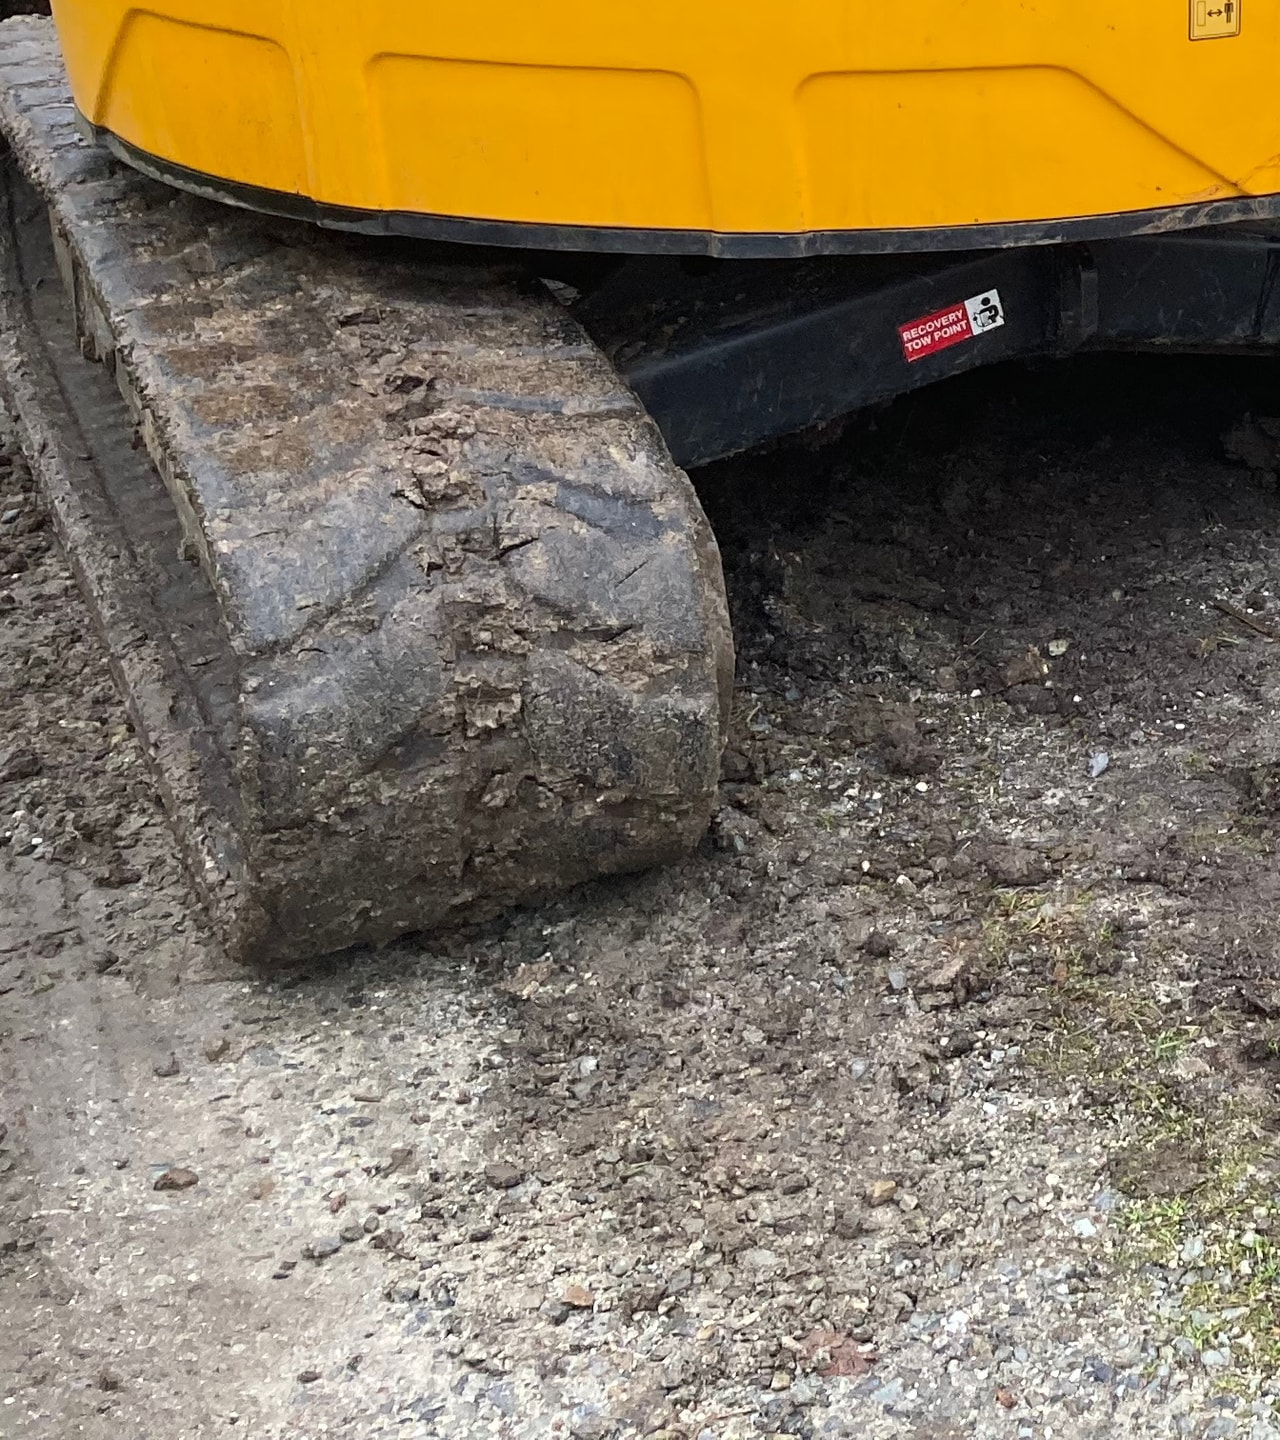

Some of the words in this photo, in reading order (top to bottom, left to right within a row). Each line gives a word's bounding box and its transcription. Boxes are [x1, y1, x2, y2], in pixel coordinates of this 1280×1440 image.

[902, 309, 963, 341] RECOVERY
[905, 334, 932, 352] TOW
[934, 320, 967, 341] POINT
